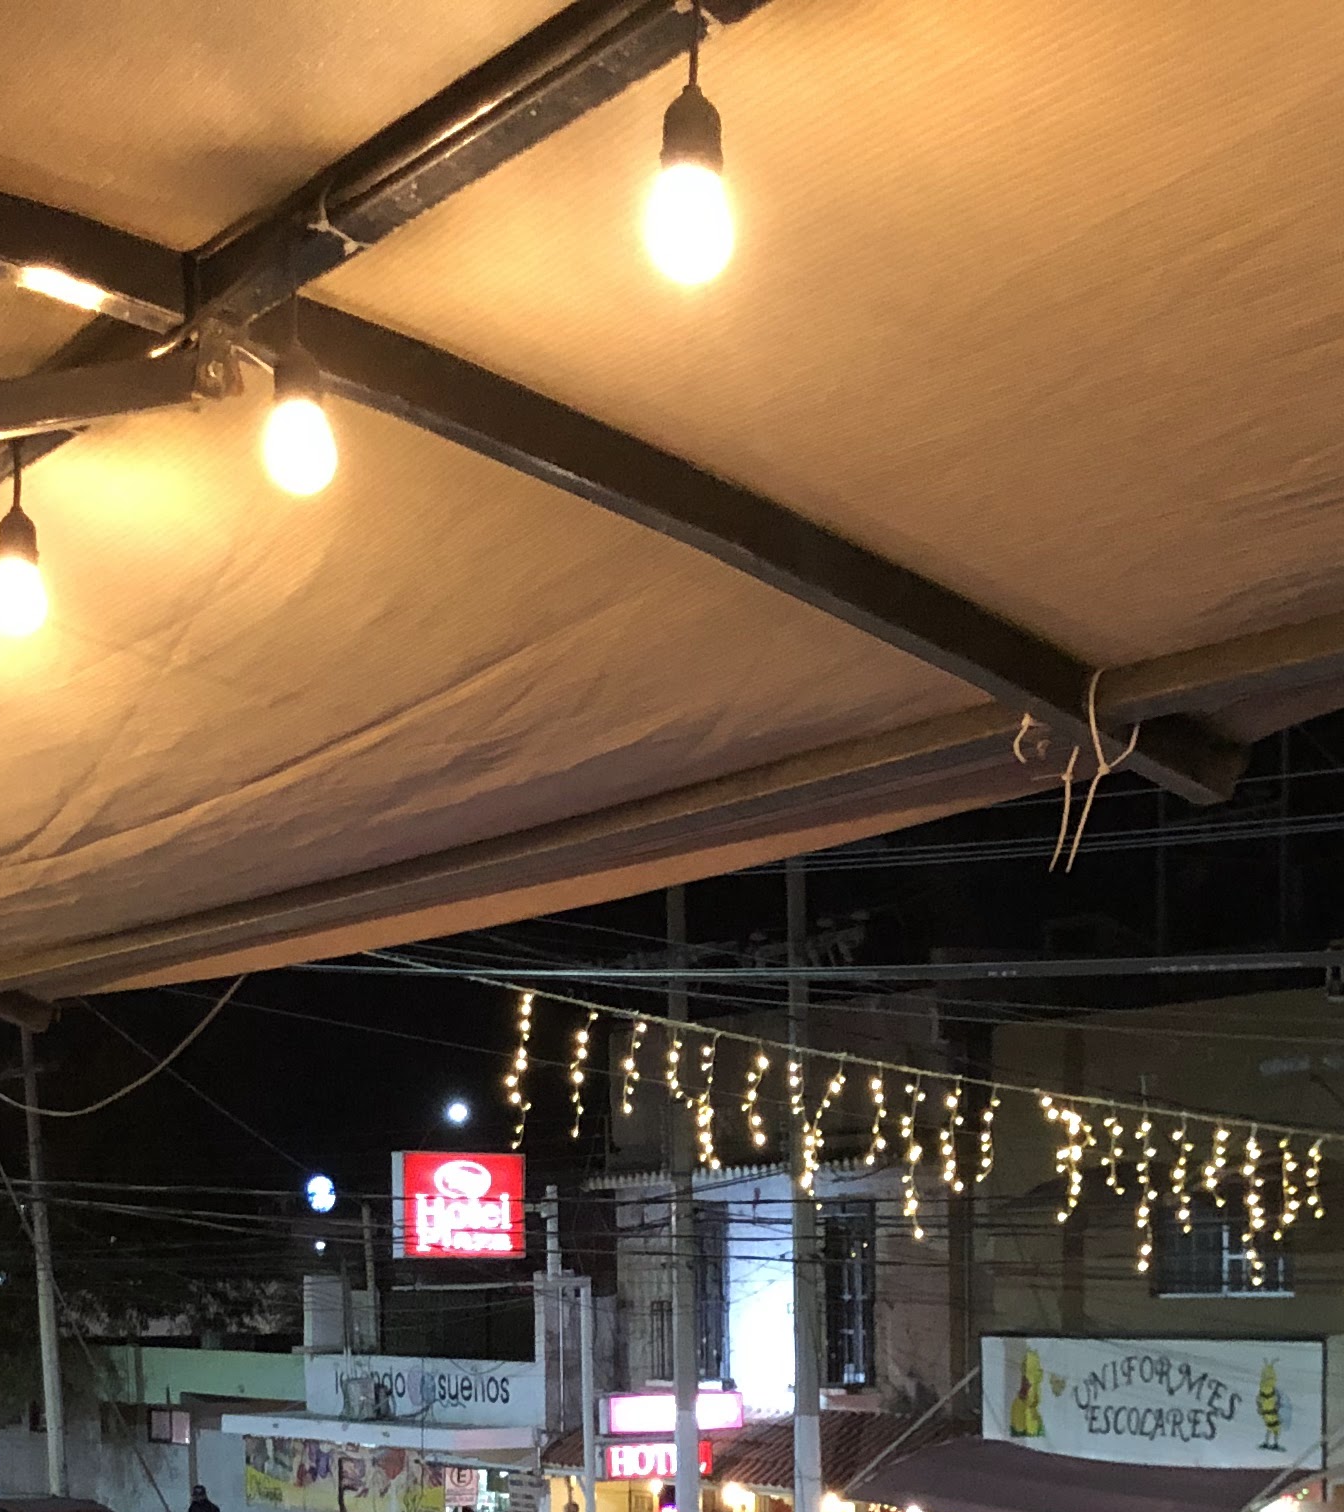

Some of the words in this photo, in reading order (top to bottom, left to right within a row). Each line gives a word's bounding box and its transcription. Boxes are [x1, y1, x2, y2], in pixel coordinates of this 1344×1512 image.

[415, 1192, 514, 1230] Hotel
[1073, 1354, 1243, 1421] UNIFORMES
[1084, 1404, 1218, 1442] ESCOLARES
